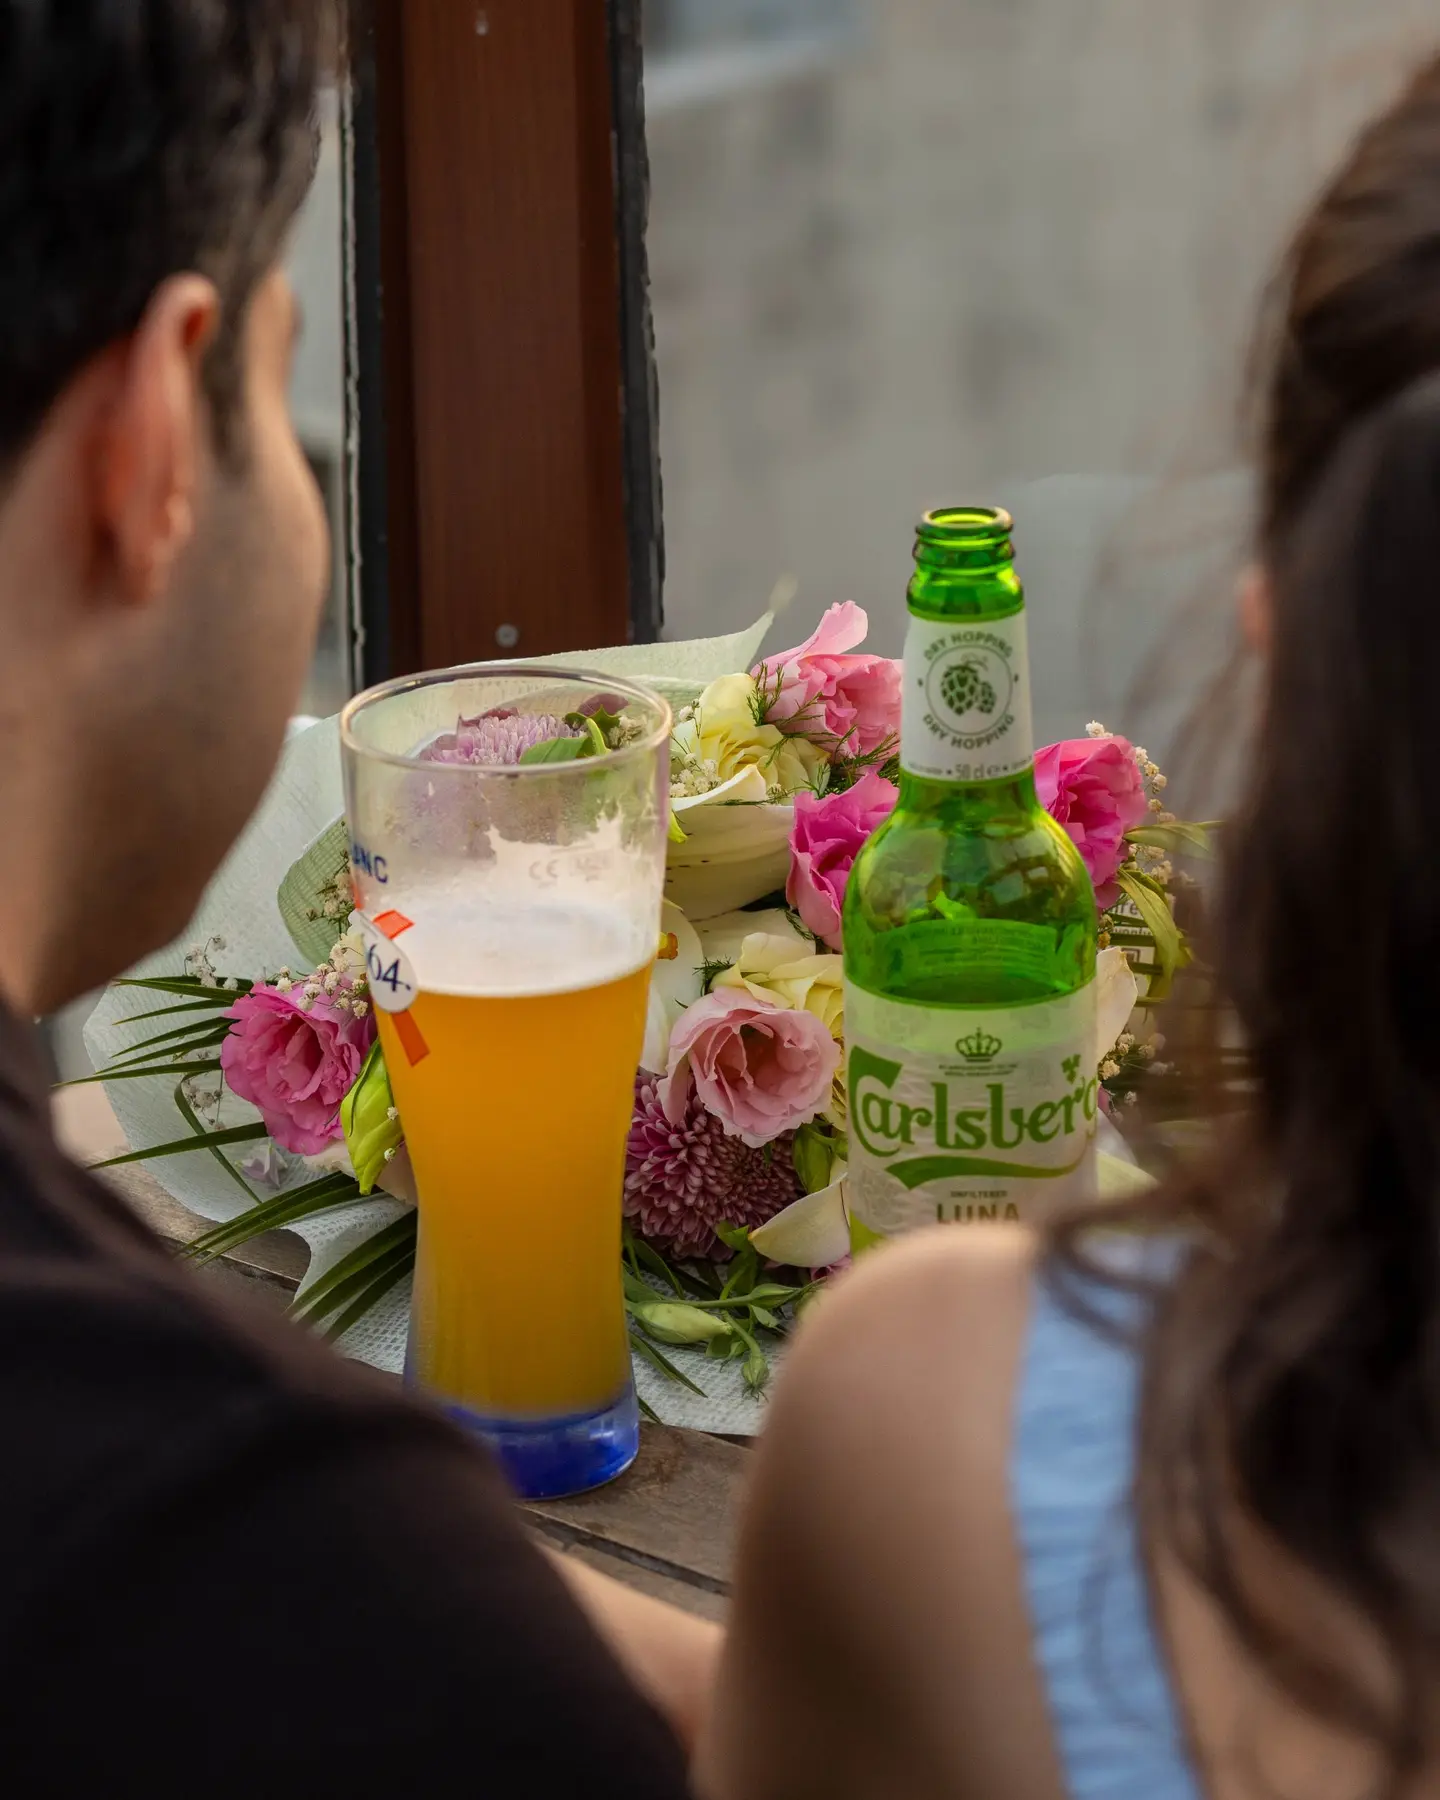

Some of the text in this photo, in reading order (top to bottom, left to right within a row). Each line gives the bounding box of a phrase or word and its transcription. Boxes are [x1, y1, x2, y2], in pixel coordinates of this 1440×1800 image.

[923, 630, 1013, 661] DRY HOPPING
[923, 713, 1015, 750] DRY HOPPING
[936, 1202, 1020, 1226] LUNA
